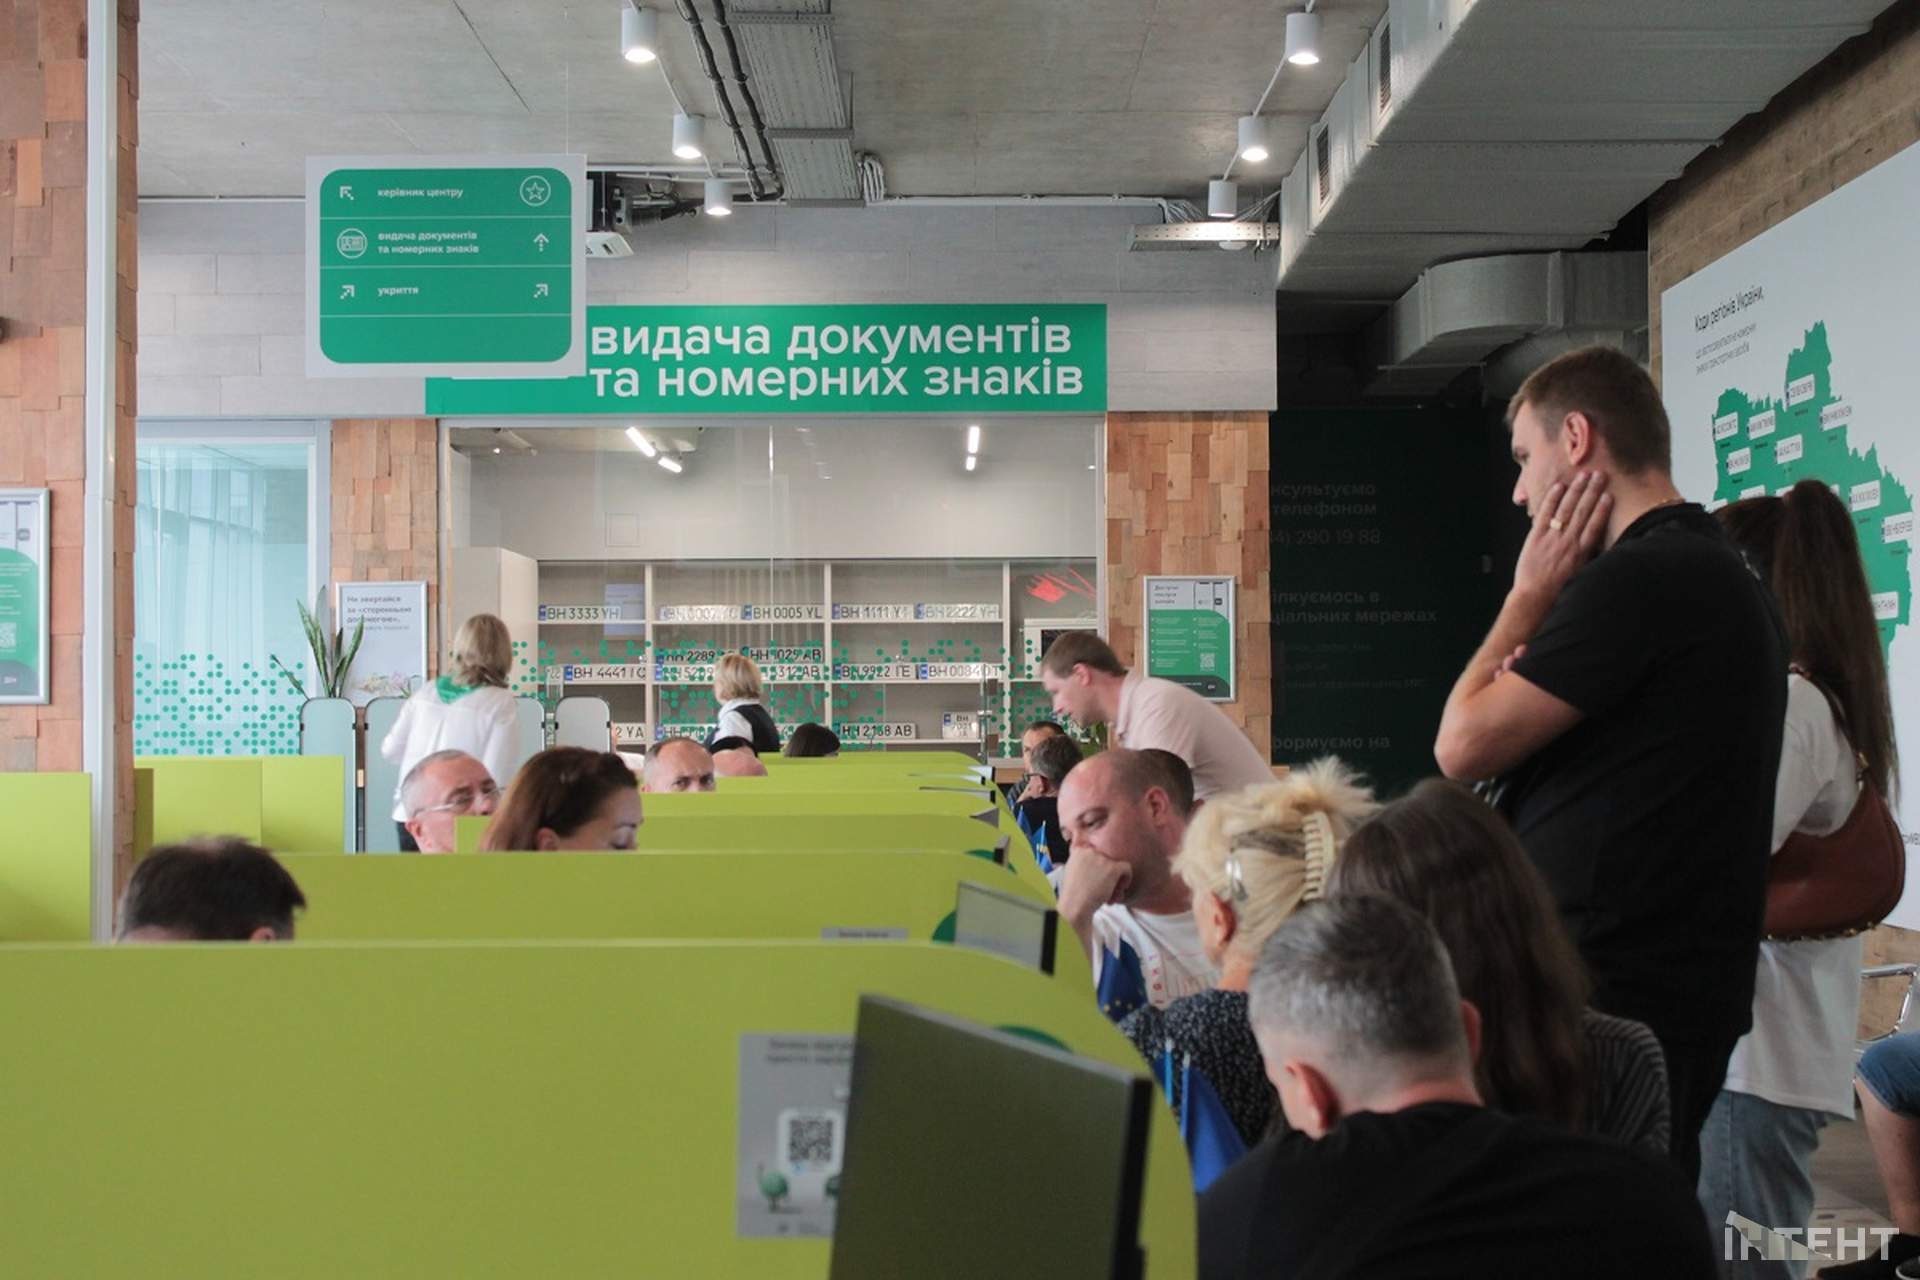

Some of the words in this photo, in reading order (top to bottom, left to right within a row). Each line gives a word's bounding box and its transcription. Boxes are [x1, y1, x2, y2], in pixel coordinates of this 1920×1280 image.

[378, 187, 424, 198] керівник
[427, 187, 463, 199] центру
[378, 232, 416, 242] видача
[418, 231, 477, 242] документів
[378, 244, 390, 253] та
[392, 244, 443, 255] номерних
[446, 243, 479, 253] знаків
[378, 286, 418, 297] укриття
[591, 324, 771, 360] видача
[787, 316, 1072, 361] документів
[589, 367, 639, 397] та
[658, 365, 909, 400] номерних
[924, 358, 1083, 396] знаків
[1271, 483, 1376, 499] нсультуємо
[547, 607, 566, 619] BH
[568, 607, 599, 619] 3333
[753, 607, 771, 619] BH
[806, 607, 822, 619] YL
[841, 606, 860, 618] BH
[863, 606, 890, 618] 1111
[772, 649, 801, 661] 029
[574, 666, 592, 678] BH
[802, 666, 820, 678] AB
[928, 666, 948, 678] BH
[627, 726, 644, 738] YA
[842, 725, 860, 737] HH
[894, 725, 912, 737] AB
